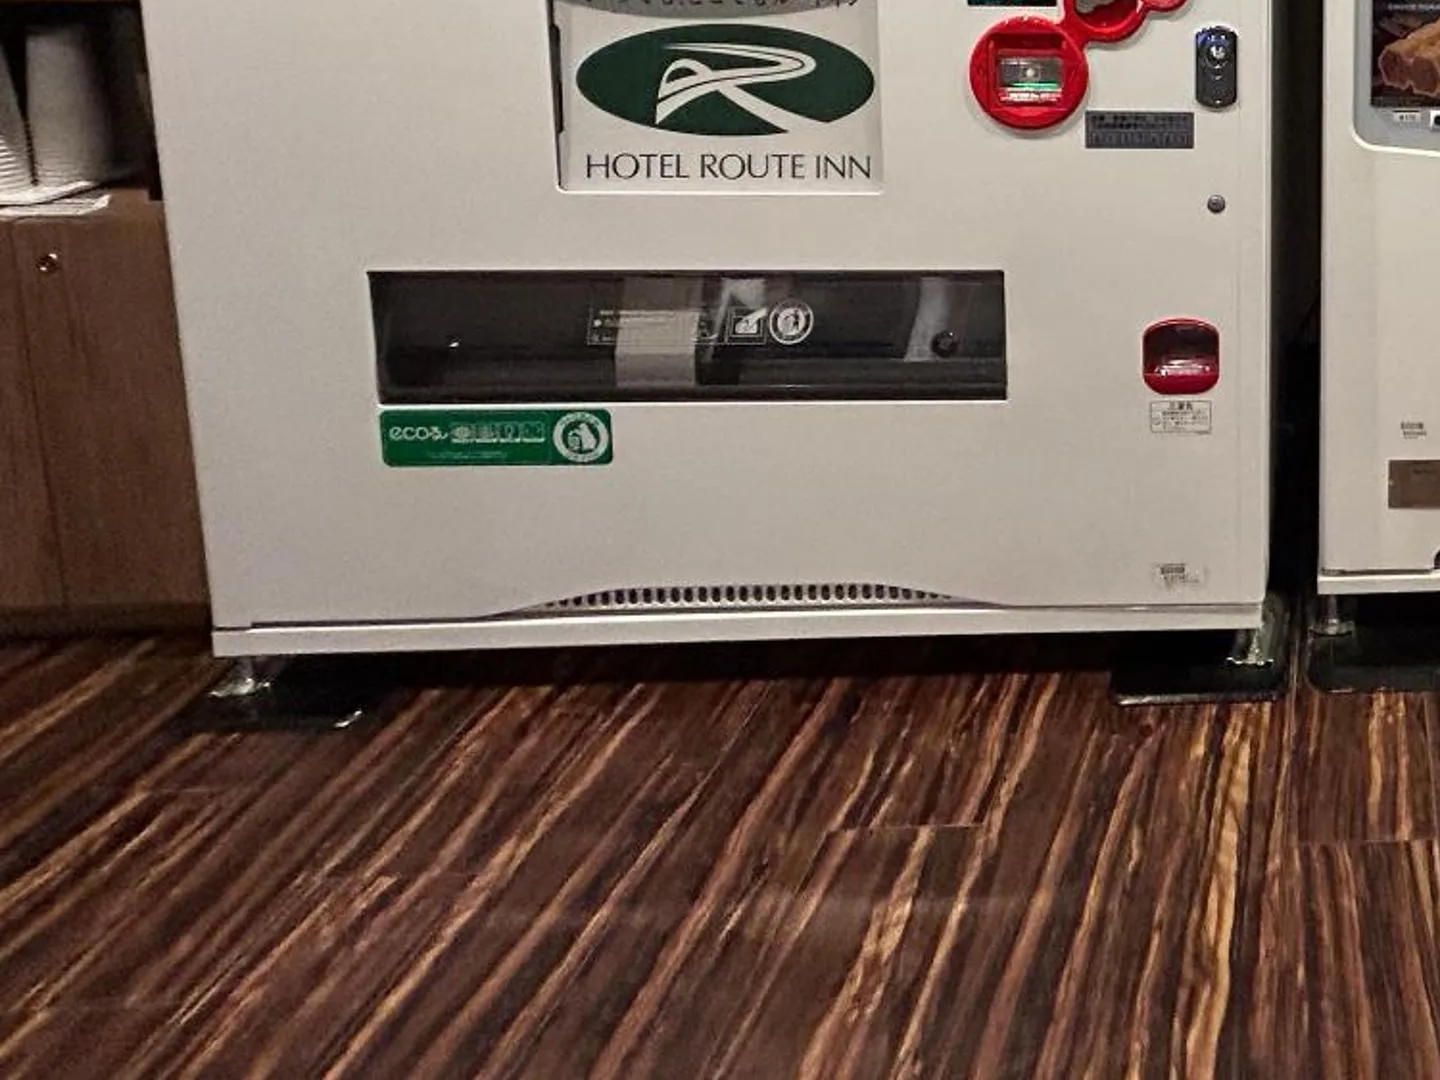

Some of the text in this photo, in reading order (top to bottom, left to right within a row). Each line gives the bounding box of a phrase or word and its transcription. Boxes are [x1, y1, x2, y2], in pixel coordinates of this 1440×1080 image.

[586, 153, 871, 179] HOTEL ROUTE INN
